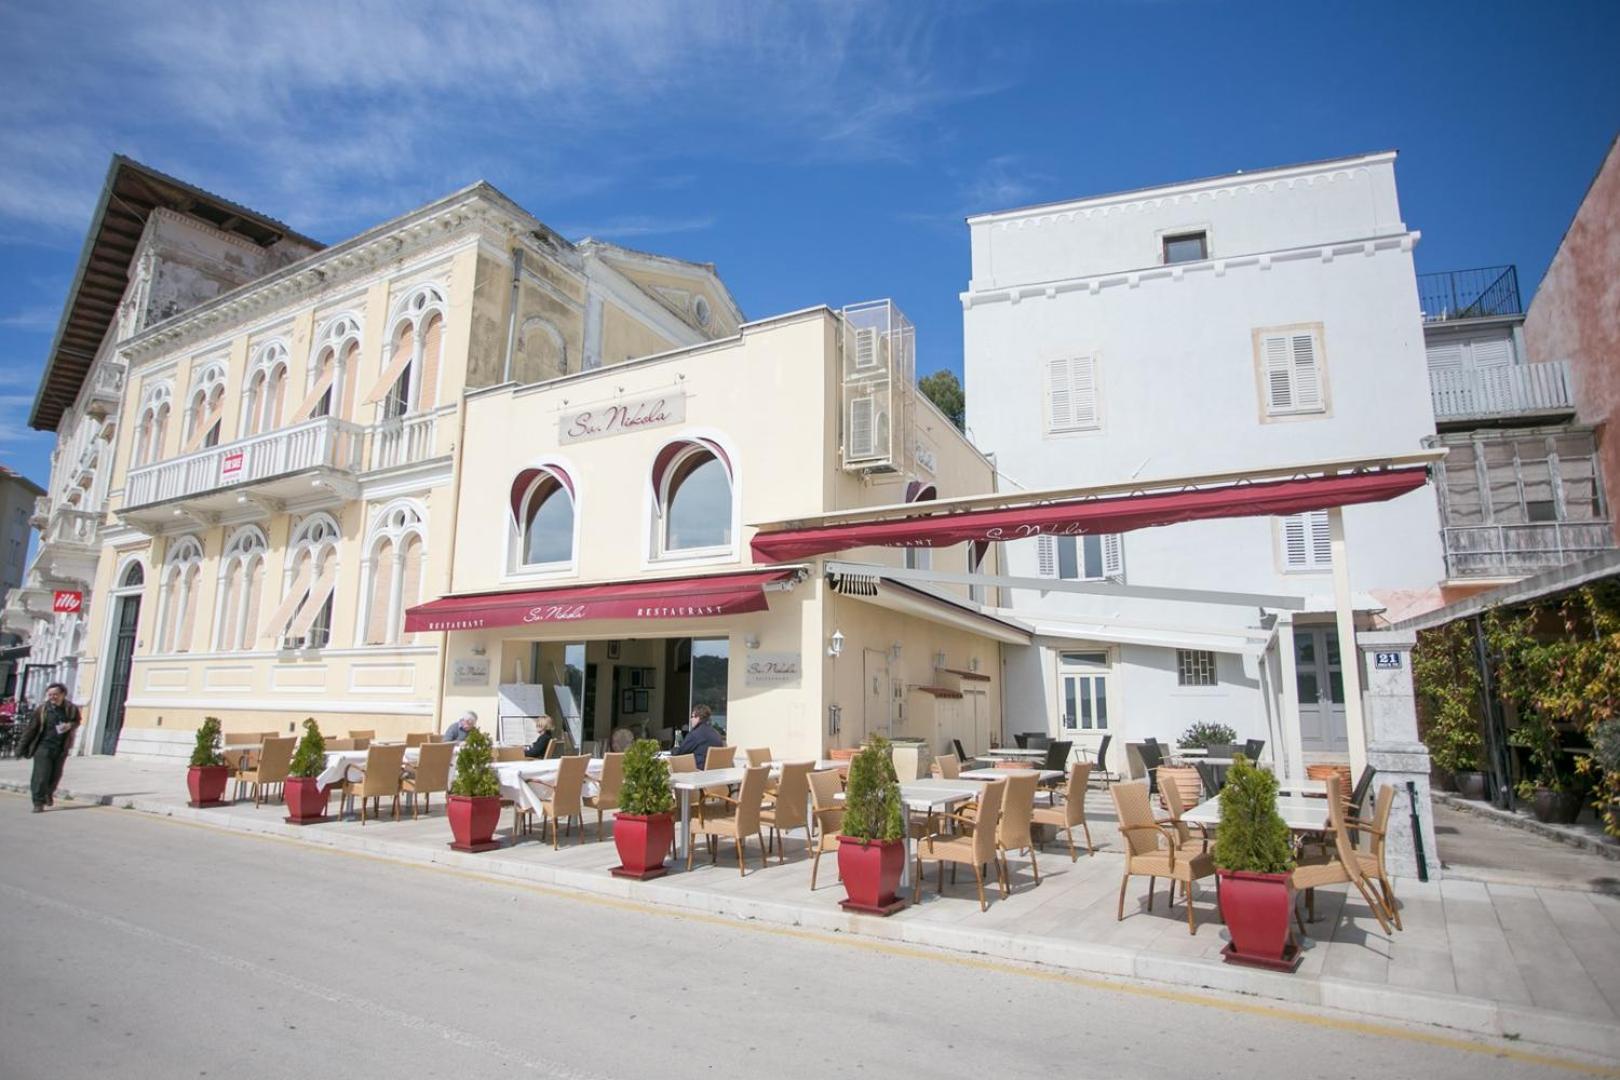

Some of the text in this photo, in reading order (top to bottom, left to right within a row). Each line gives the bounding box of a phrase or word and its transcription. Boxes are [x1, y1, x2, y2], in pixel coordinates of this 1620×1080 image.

[603, 399, 672, 431] Nikola
[55, 593, 81, 611] illy
[428, 619, 485, 630] RESTAURANT
[544, 604, 587, 620] Nikola
[636, 605, 722, 617] RESTAURANT
[1379, 653, 1397, 663] 21
